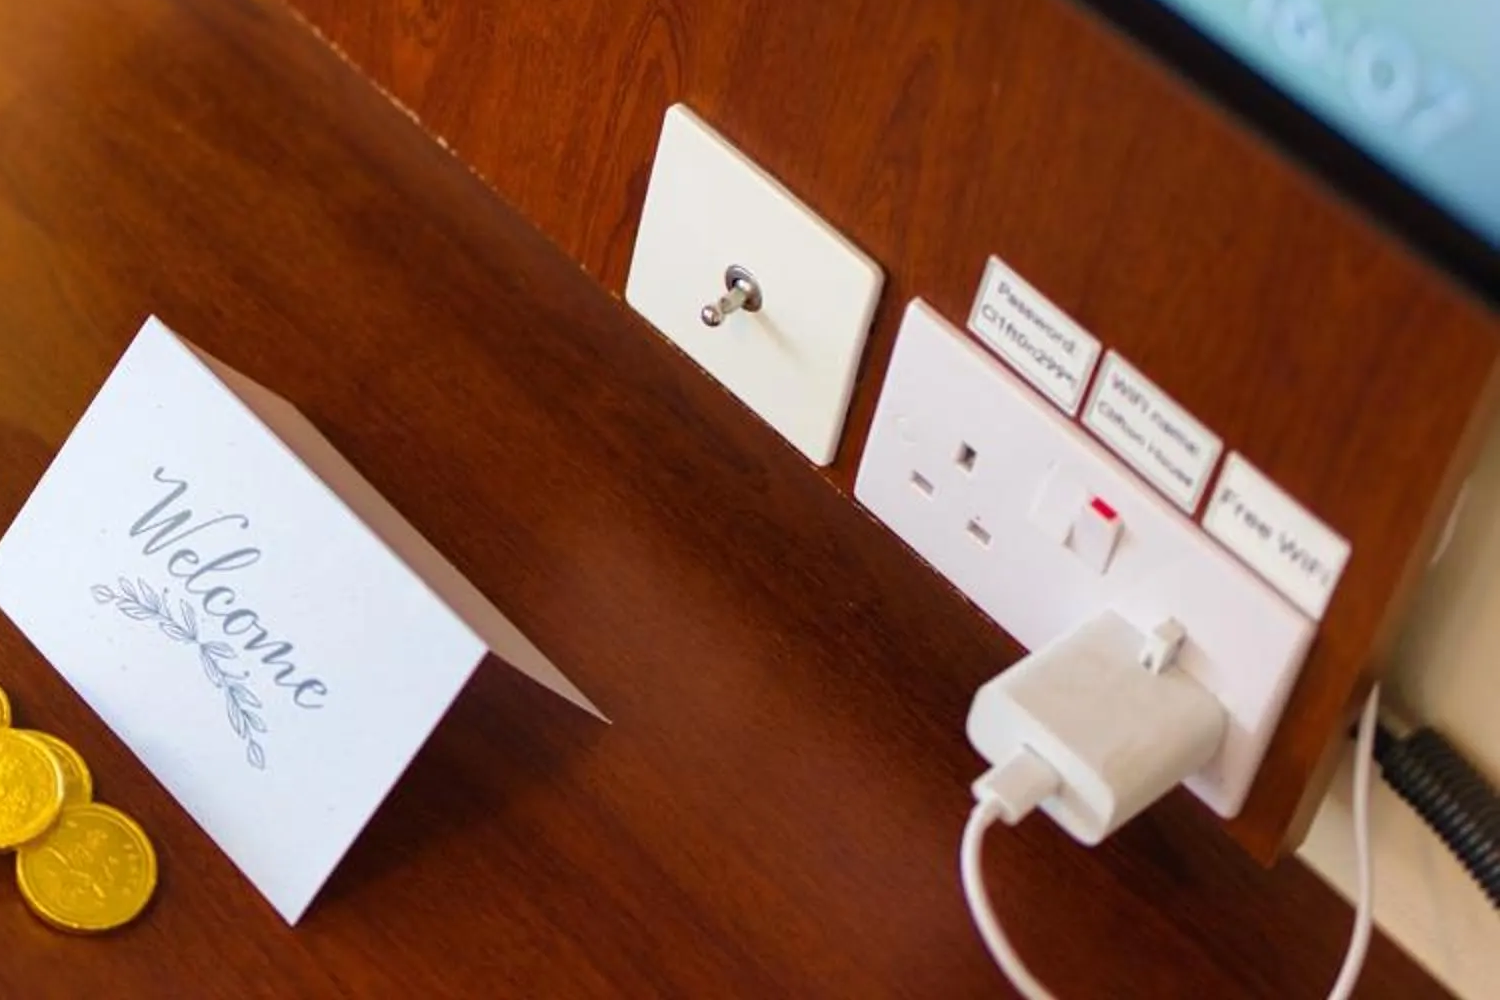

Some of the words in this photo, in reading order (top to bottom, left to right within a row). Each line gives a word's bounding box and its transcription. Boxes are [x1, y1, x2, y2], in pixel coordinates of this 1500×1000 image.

[997, 281, 1076, 354] Password
[1219, 487, 1272, 541] Free
[128, 466, 329, 711] Welcome
